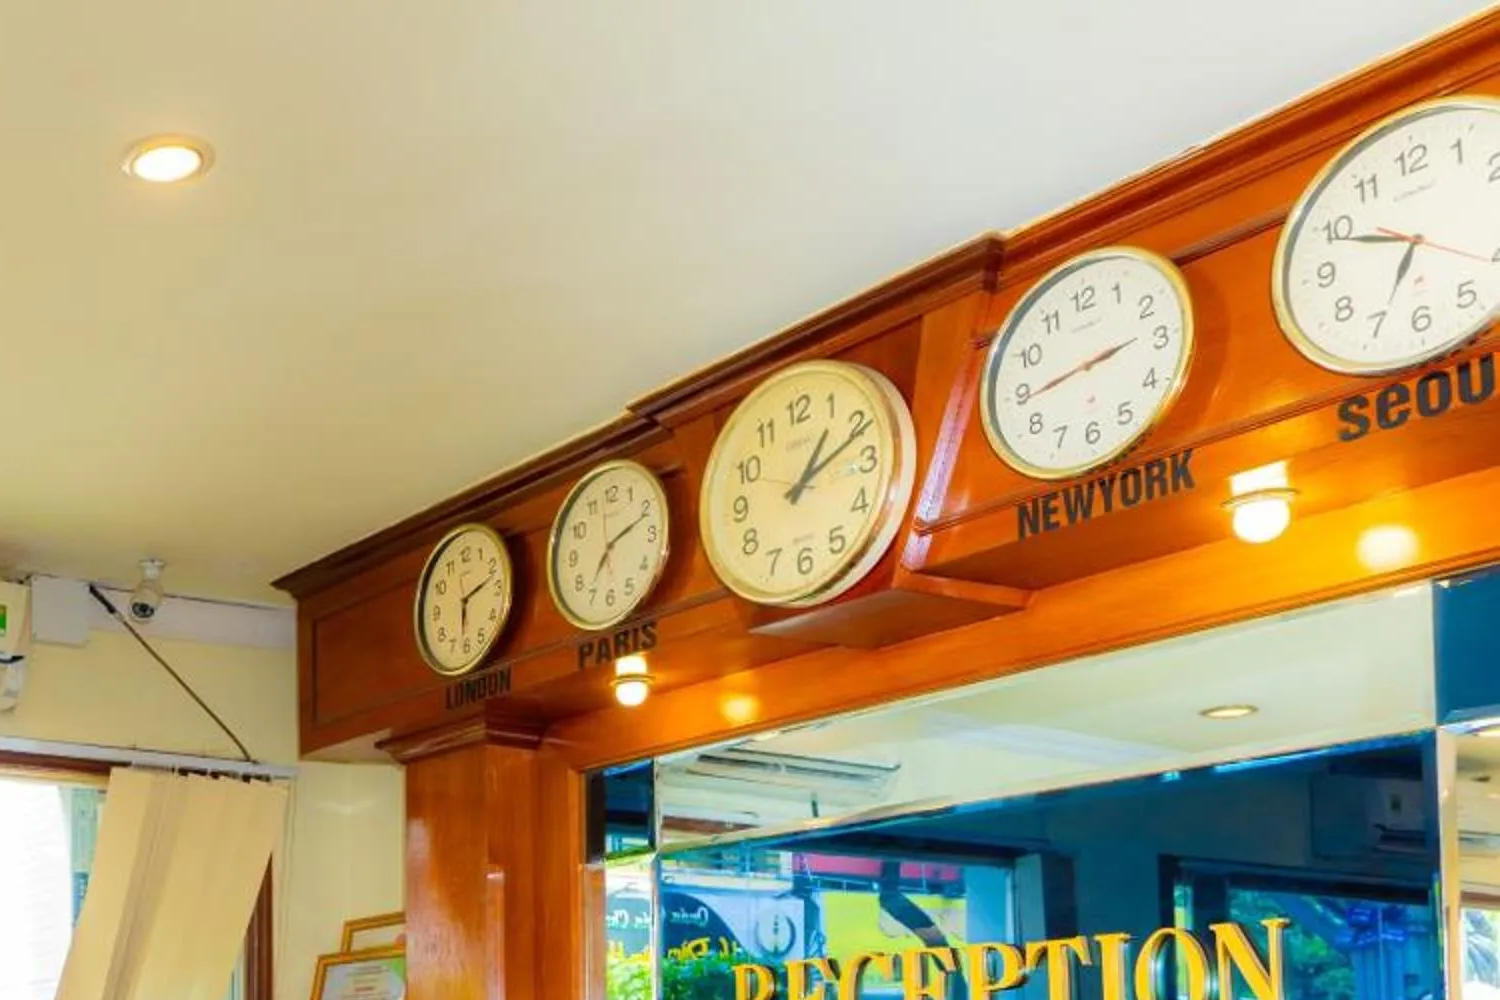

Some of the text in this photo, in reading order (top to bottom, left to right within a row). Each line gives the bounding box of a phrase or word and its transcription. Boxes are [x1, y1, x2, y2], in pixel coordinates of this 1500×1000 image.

[1394, 144, 1428, 176] 12
[1450, 138, 1462, 164] 1
[1354, 174, 1378, 203] 11
[1322, 215, 1352, 244] 10
[1317, 262, 1335, 287] 9
[1071, 286, 1095, 313] 12
[1112, 283, 1121, 304] 1
[1456, 280, 1477, 309] 5
[1139, 295, 1155, 319] 2
[1335, 296, 1353, 322] 8
[1042, 311, 1060, 334] 11
[1367, 311, 1387, 339] 7
[1411, 306, 1431, 332] 6
[1153, 325, 1169, 349] 3
[1020, 343, 1042, 368] 10
[1142, 368, 1158, 389] 4
[827, 393, 835, 418] 1
[1016, 383, 1030, 405] 9
[786, 394, 811, 425] 12
[1118, 402, 1133, 425] 5
[757, 419, 774, 448] 11
[849, 410, 865, 437] 2
[1030, 413, 1043, 434] 8
[1086, 422, 1100, 444] 6
[1053, 426, 1068, 449] 7
[737, 455, 761, 484] 10
[860, 445, 877, 474] 3
[605, 486, 618, 502] 12
[628, 488, 633, 501] 1
[851, 488, 868, 514] 4
[1017, 448, 1195, 540] NEWYORK
[588, 501, 597, 515] 11
[642, 500, 650, 516] 2
[733, 496, 748, 522] 9
[573, 522, 586, 539] 10
[648, 526, 656, 543] 3
[742, 529, 758, 555] 8
[830, 526, 845, 554] 5
[459, 547, 470, 563] 12
[478, 548, 483, 561] 1
[569, 551, 578, 567] 9
[639, 555, 648, 570] 4
[767, 549, 782, 576] 7
[798, 547, 813, 574] 6
[446, 560, 454, 575] 11
[488, 558, 496, 575] 2
[435, 580, 446, 595] 10
[575, 575, 584, 592] 8
[625, 578, 635, 595] 5
[589, 589, 597, 605] 7
[606, 589, 615, 606] 6
[433, 606, 440, 621] 9
[488, 608, 496, 621] 4
[438, 627, 446, 642] 8
[450, 639, 456, 652] 7
[463, 639, 470, 653] 6
[477, 628, 484, 644] 5
[577, 622, 658, 669] PARIS
[445, 665, 512, 710] LONDON
